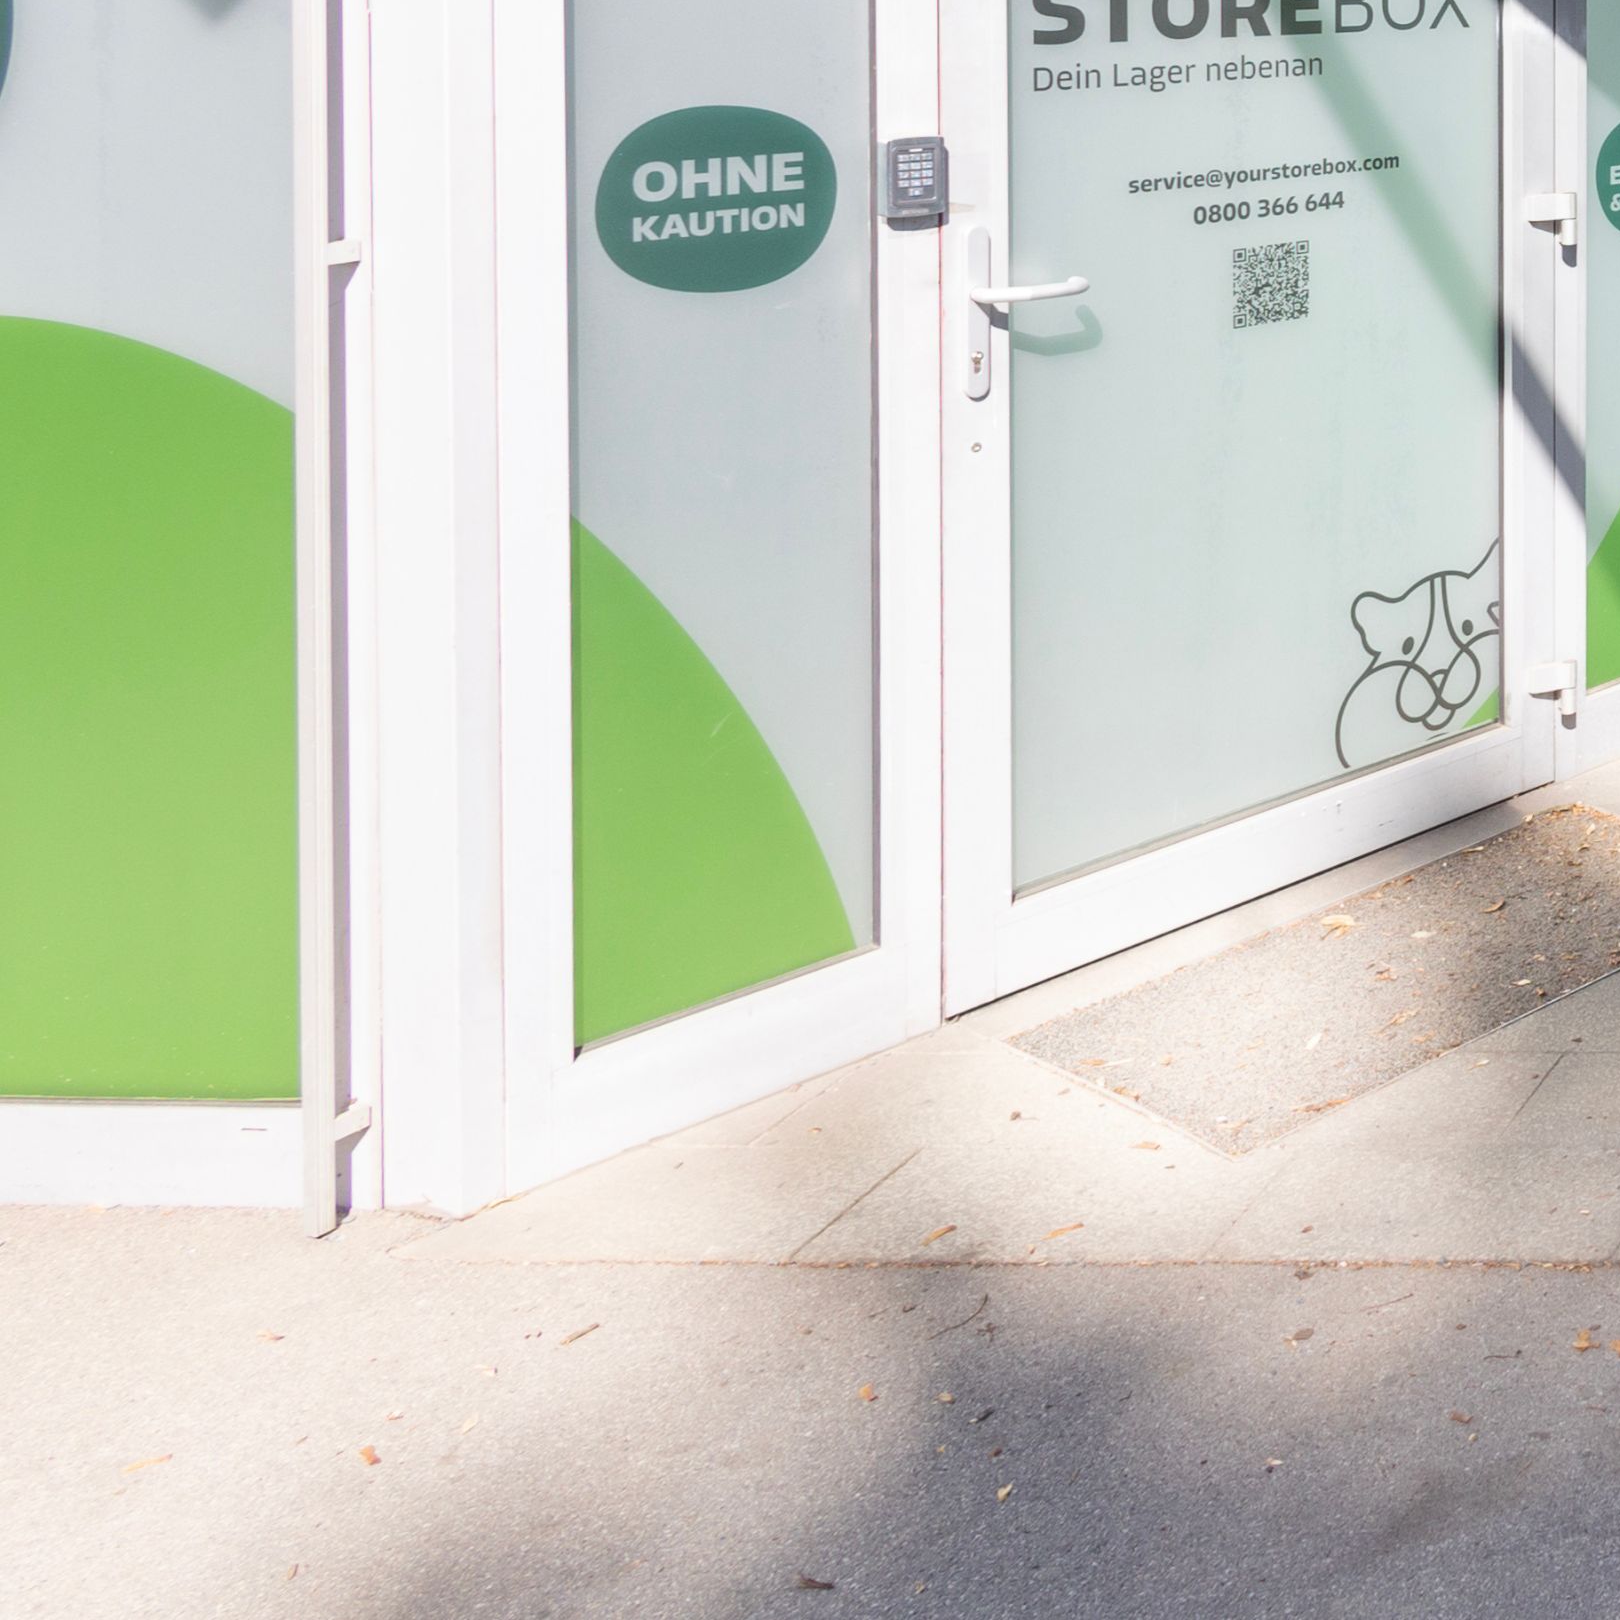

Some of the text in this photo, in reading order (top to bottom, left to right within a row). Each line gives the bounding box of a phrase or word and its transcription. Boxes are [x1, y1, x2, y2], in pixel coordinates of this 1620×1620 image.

[1033, 55, 1323, 93] Dein Lager nebenan
[632, 151, 805, 203] OHNE
[1128, 152, 1400, 194] service@yourstorebox.com
[632, 203, 805, 243] KAUTION
[1193, 190, 1345, 225] 0800 366 644
